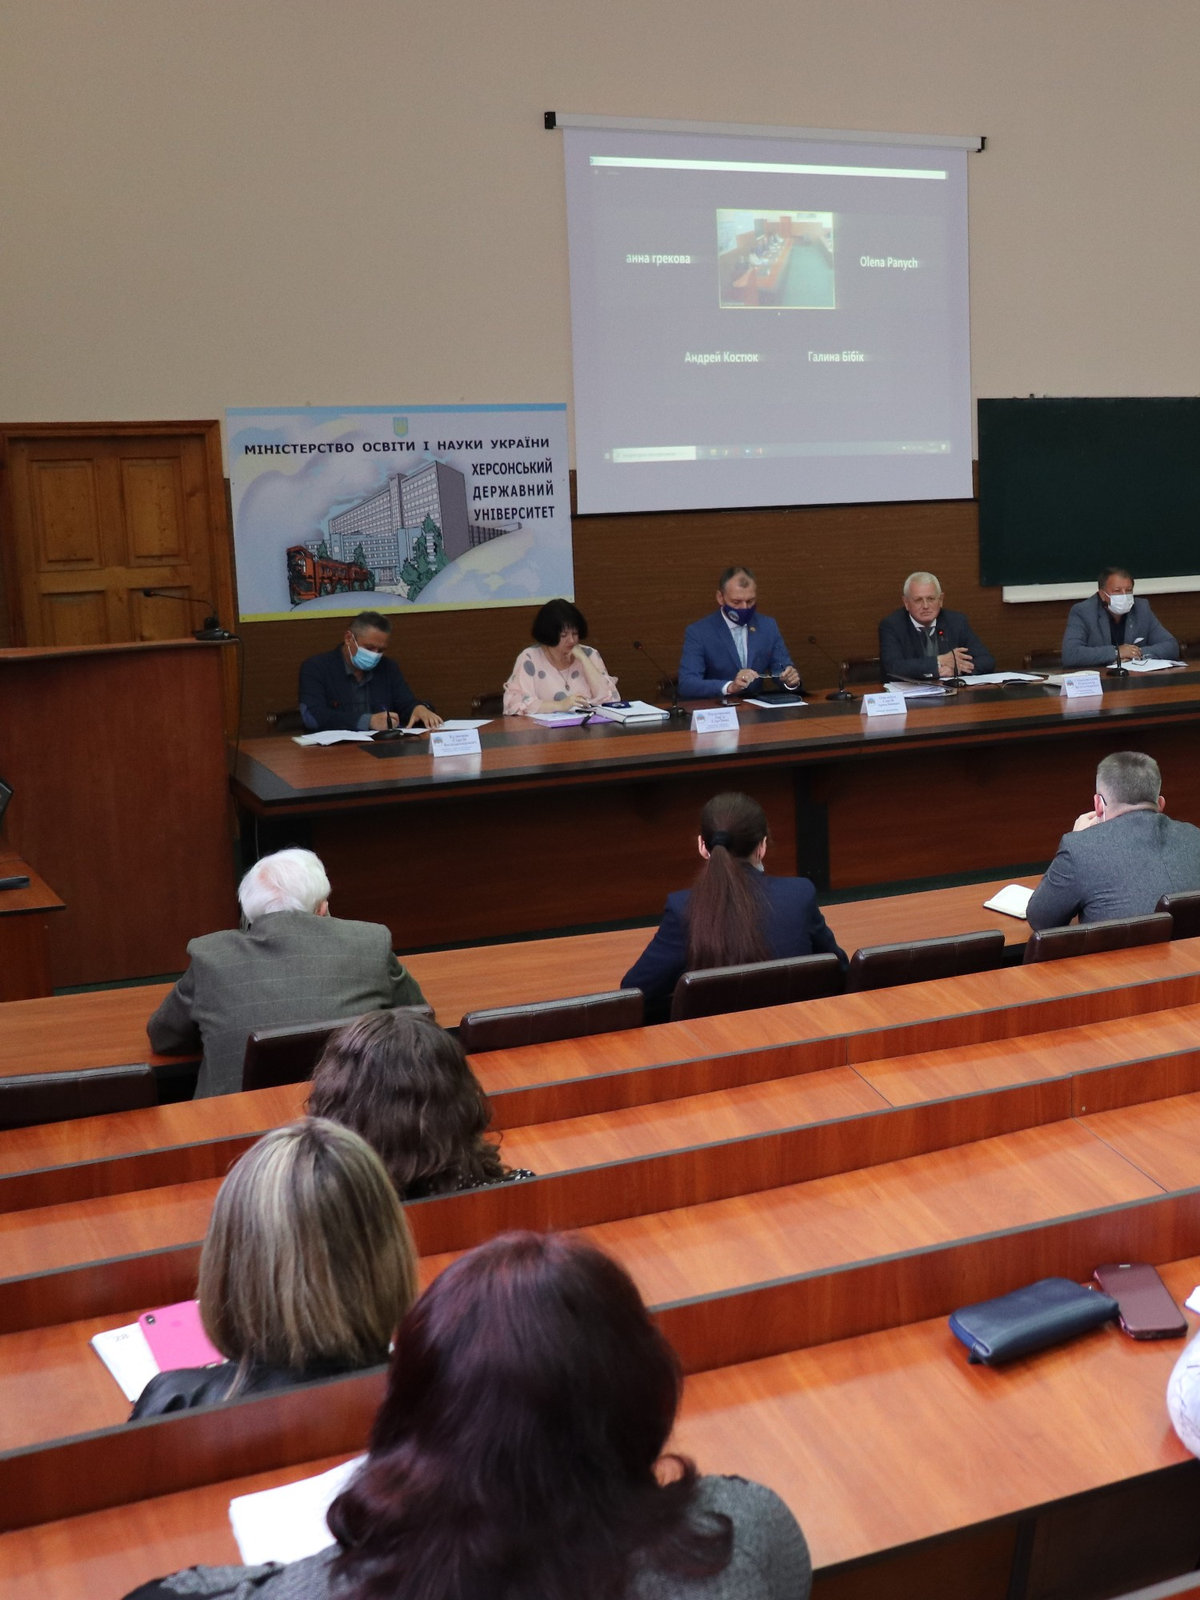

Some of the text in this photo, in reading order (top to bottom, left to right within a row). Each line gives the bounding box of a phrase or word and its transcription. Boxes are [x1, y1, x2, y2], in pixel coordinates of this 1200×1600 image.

[625, 254, 691, 267] анна грекова
[860, 256, 918, 271] Olena Panych
[684, 350, 759, 365] Андрей Костюк
[808, 351, 840, 362] Галина
[244, 443, 355, 455] МІНІСТЕРСТВО
[362, 441, 416, 453] ОСВІТИ
[437, 440, 483, 451] НАУКИ
[490, 436, 550, 449] УКРАЇНИ
[471, 457, 553, 476] ХЕРСОНСЬКИЙ
[473, 480, 554, 501] ДЕРЖАВНИЙ
[474, 506, 555, 521] УНІВЕРСИТЕТ
